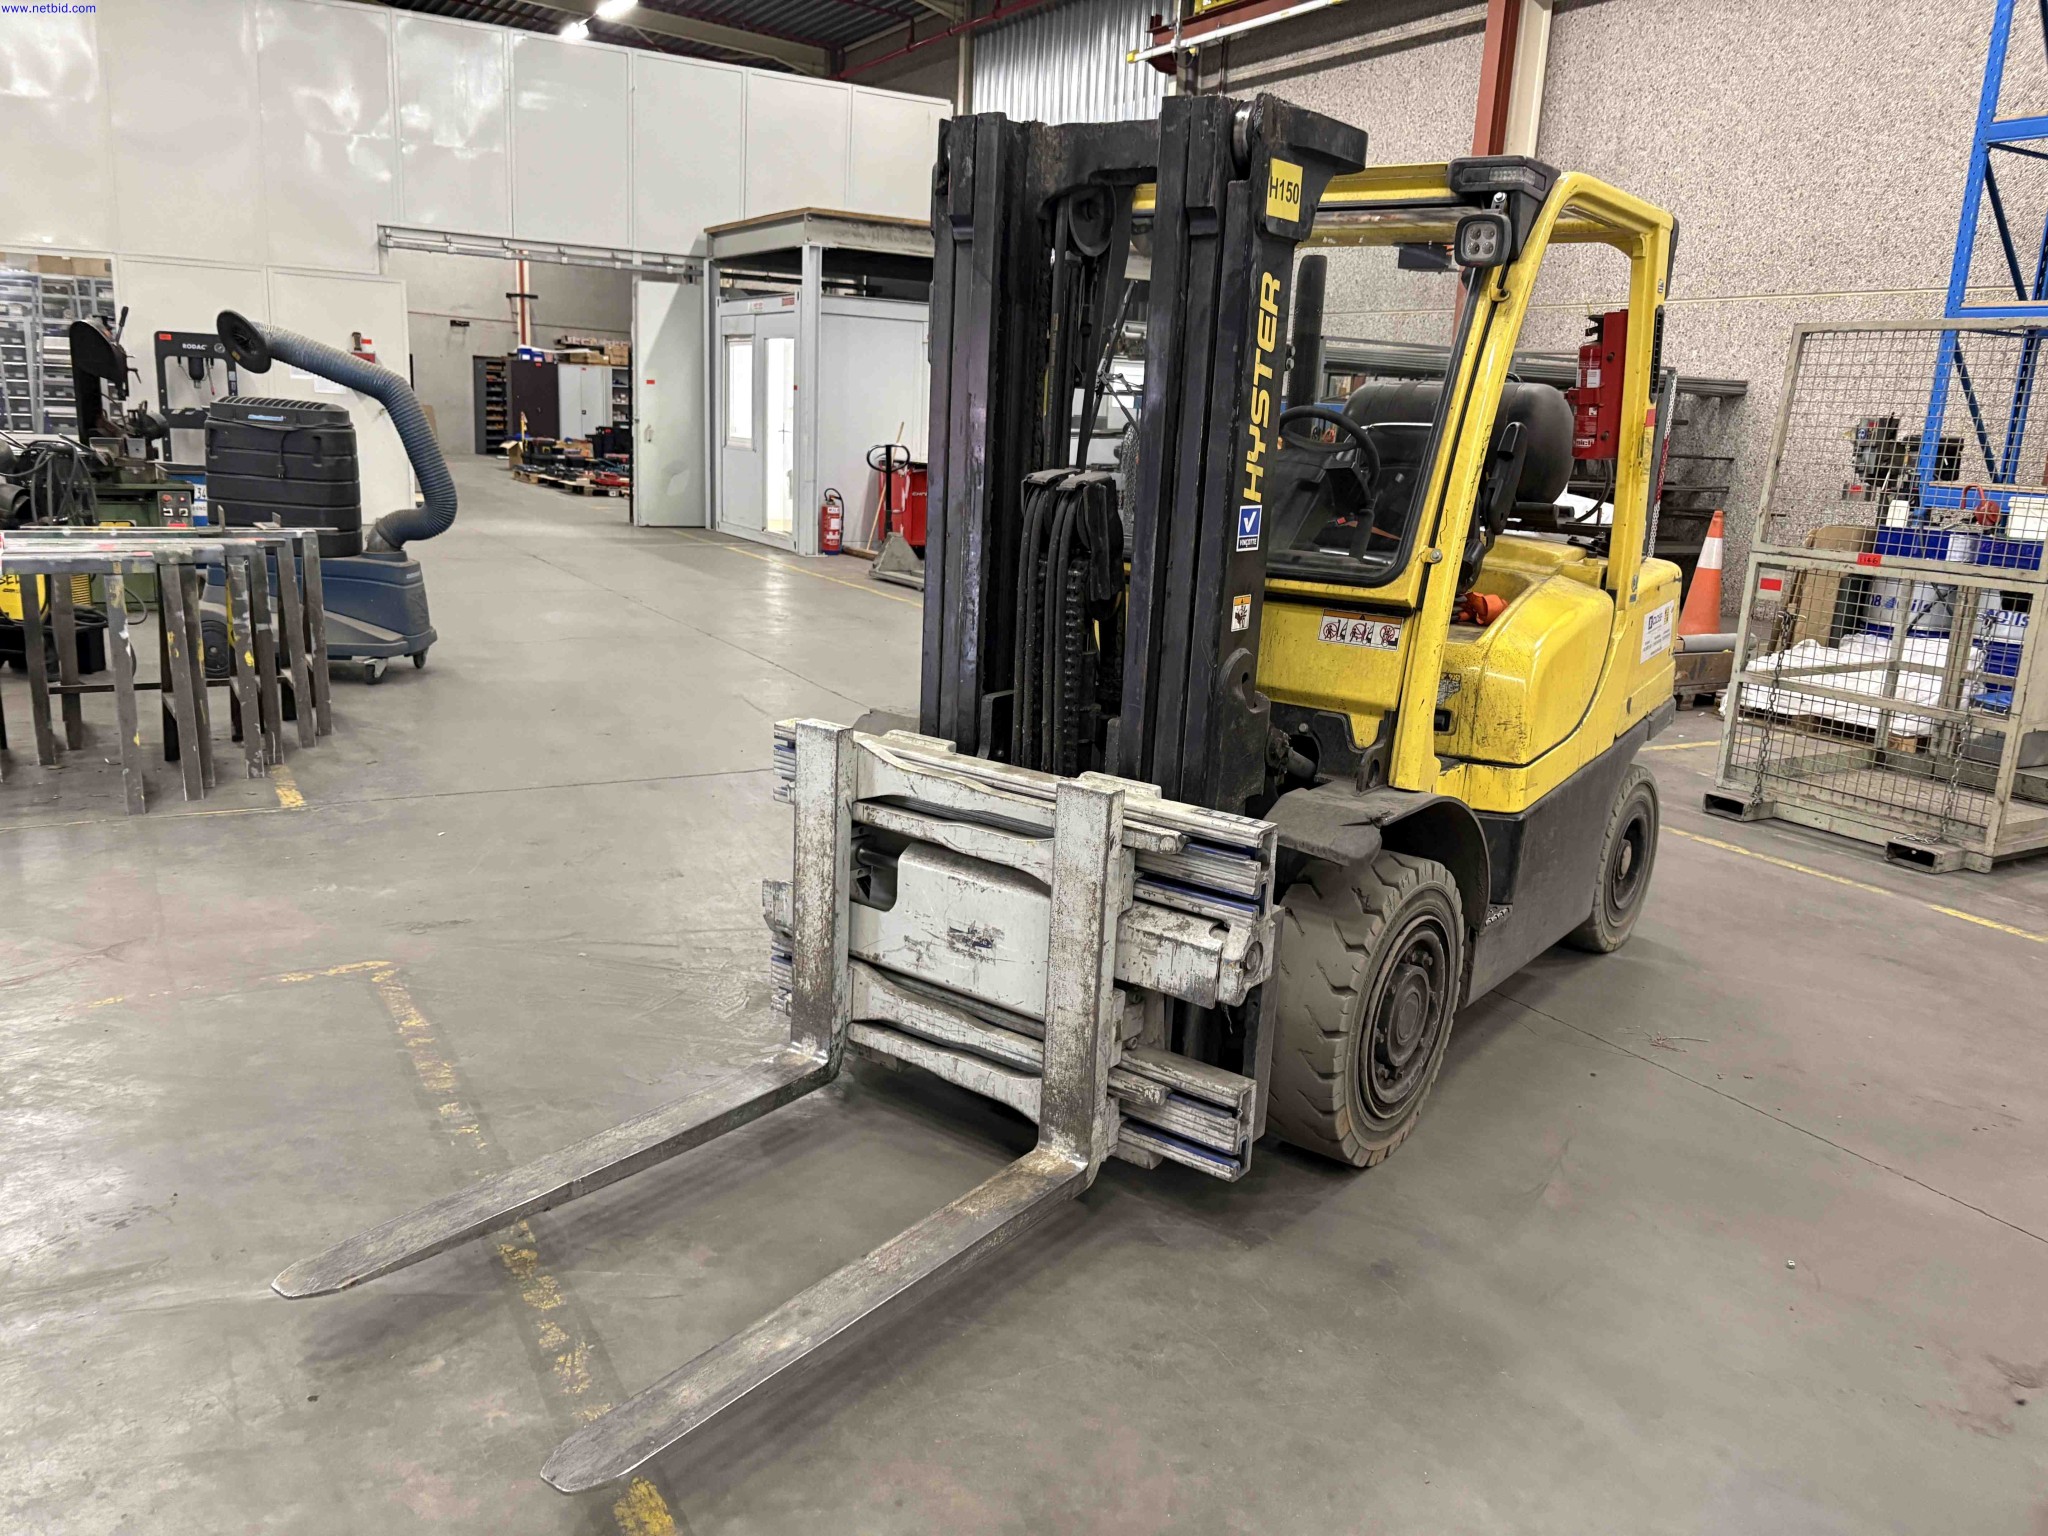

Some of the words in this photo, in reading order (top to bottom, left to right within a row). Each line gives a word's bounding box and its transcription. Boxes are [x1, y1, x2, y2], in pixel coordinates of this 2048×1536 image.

[1269, 175, 1300, 205] H150
[1243, 271, 1281, 503] HYSTER
[1871, 594, 1882, 607] 8
